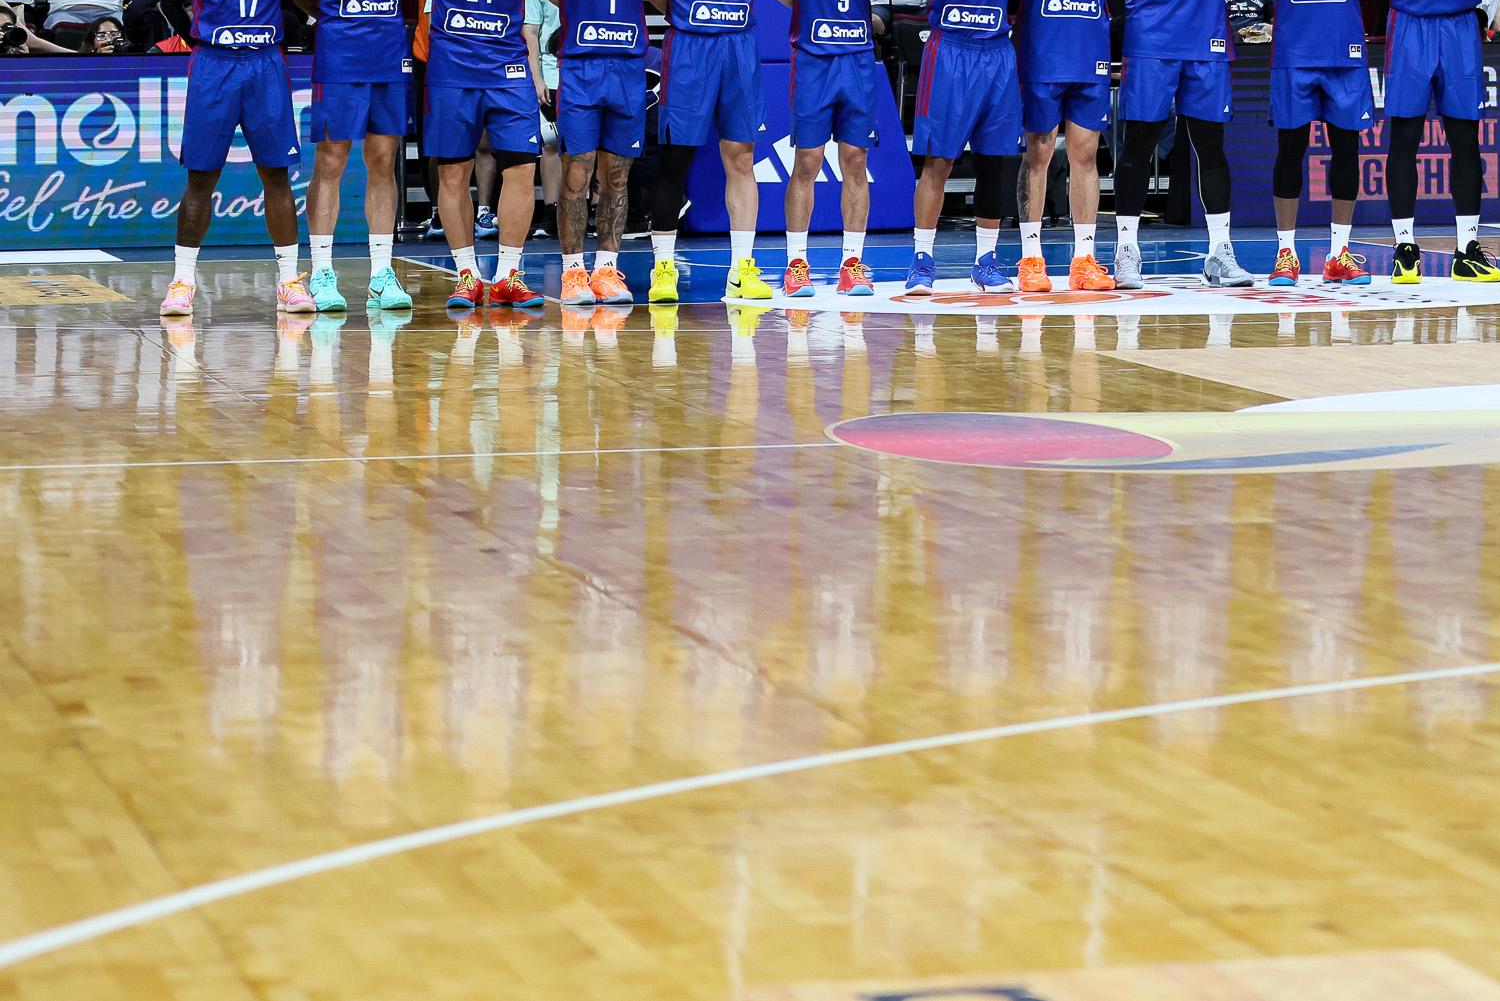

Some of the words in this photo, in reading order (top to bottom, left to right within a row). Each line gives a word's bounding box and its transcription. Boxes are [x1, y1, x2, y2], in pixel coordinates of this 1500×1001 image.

[710, 7, 745, 22] Smart
[960, 10, 996, 25] Smart
[465, 16, 504, 32] Smart
[832, 25, 865, 38] Smart
[234, 31, 274, 44] Smart
[597, 27, 634, 42] Smart
[61, 179, 147, 227] the
